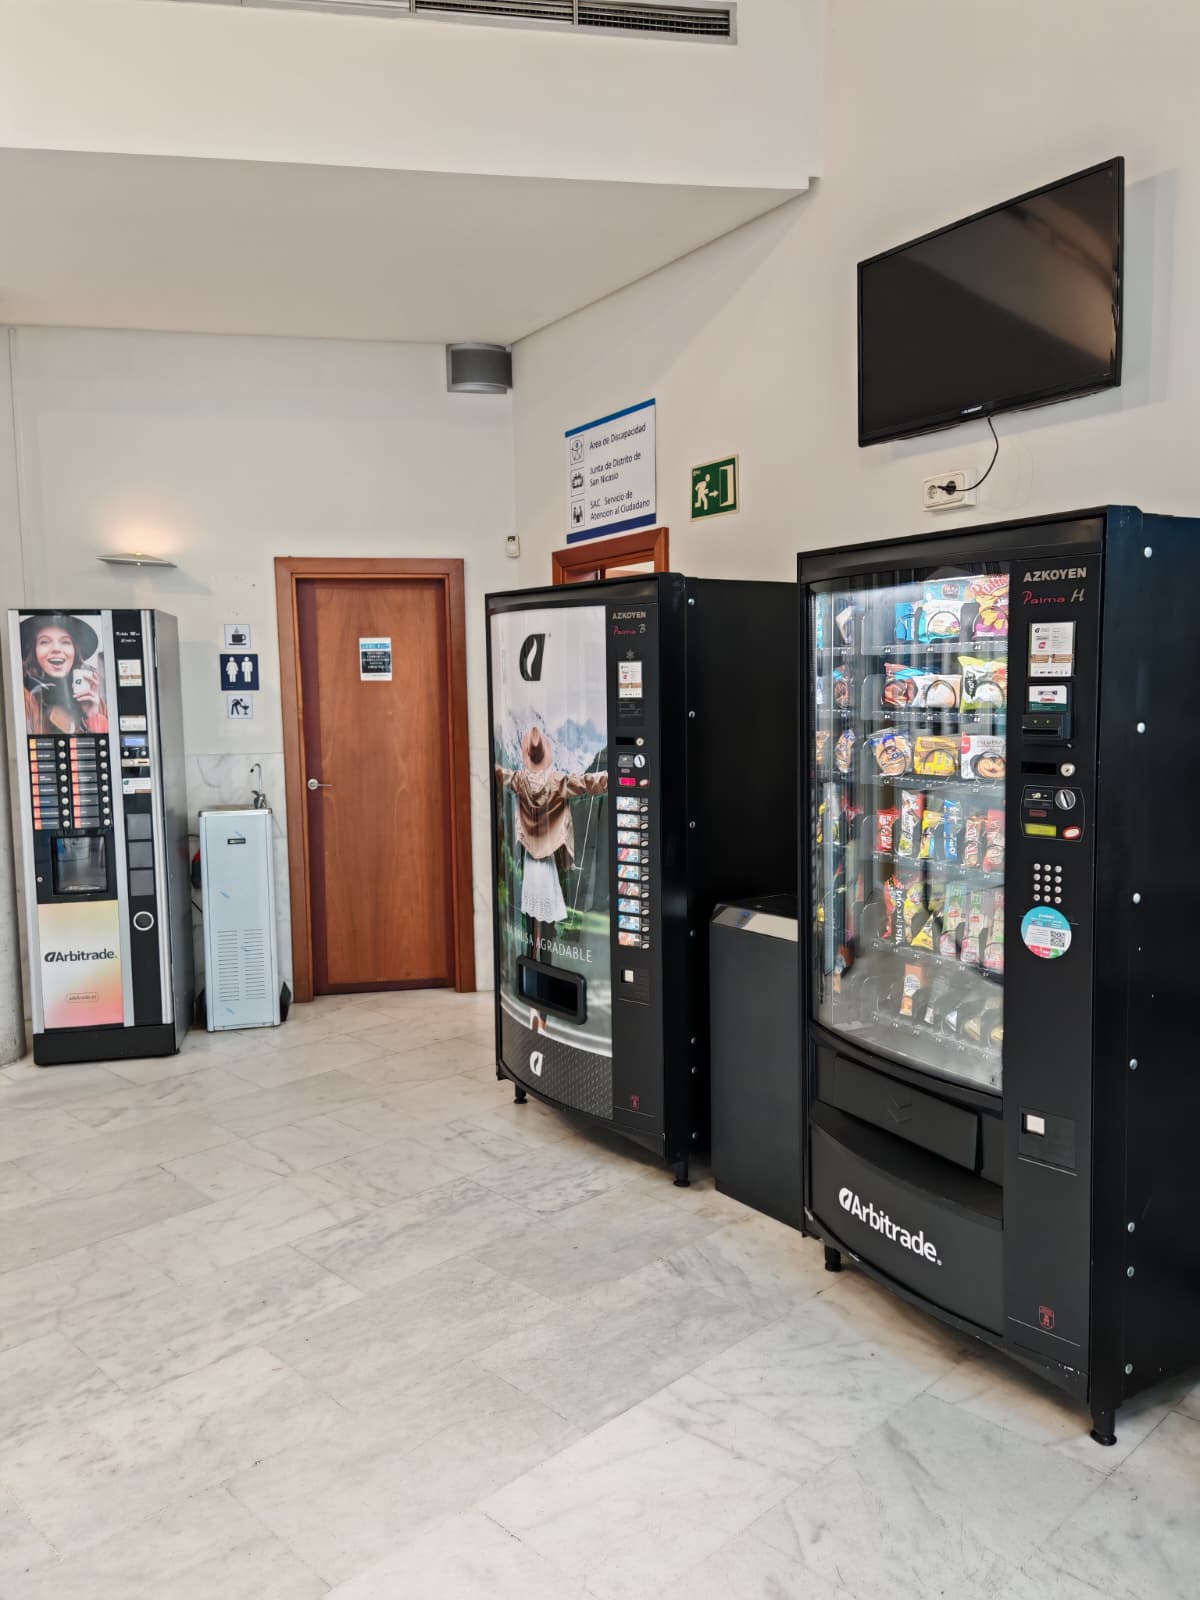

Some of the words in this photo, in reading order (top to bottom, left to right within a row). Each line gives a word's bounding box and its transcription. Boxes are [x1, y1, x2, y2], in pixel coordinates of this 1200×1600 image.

[602, 437, 610, 446] de
[610, 422, 646, 443] Discapacidad
[590, 463, 604, 474] Junta
[604, 460, 612, 470] de
[612, 455, 633, 468] Distrito
[633, 450, 641, 460] de
[590, 477, 600, 487] San
[600, 472, 619, 484] Nicasio
[604, 493, 625, 505] Servicio
[625, 490, 633, 499] de
[614, 506, 620, 515] al
[620, 499, 651, 513] Ciudadano
[1023, 567, 1087, 582] AZKOYEN
[1070, 588, 1085, 603] H
[612, 611, 647, 620] AZKOYEN
[536, 937, 593, 963] AGRADABLE
